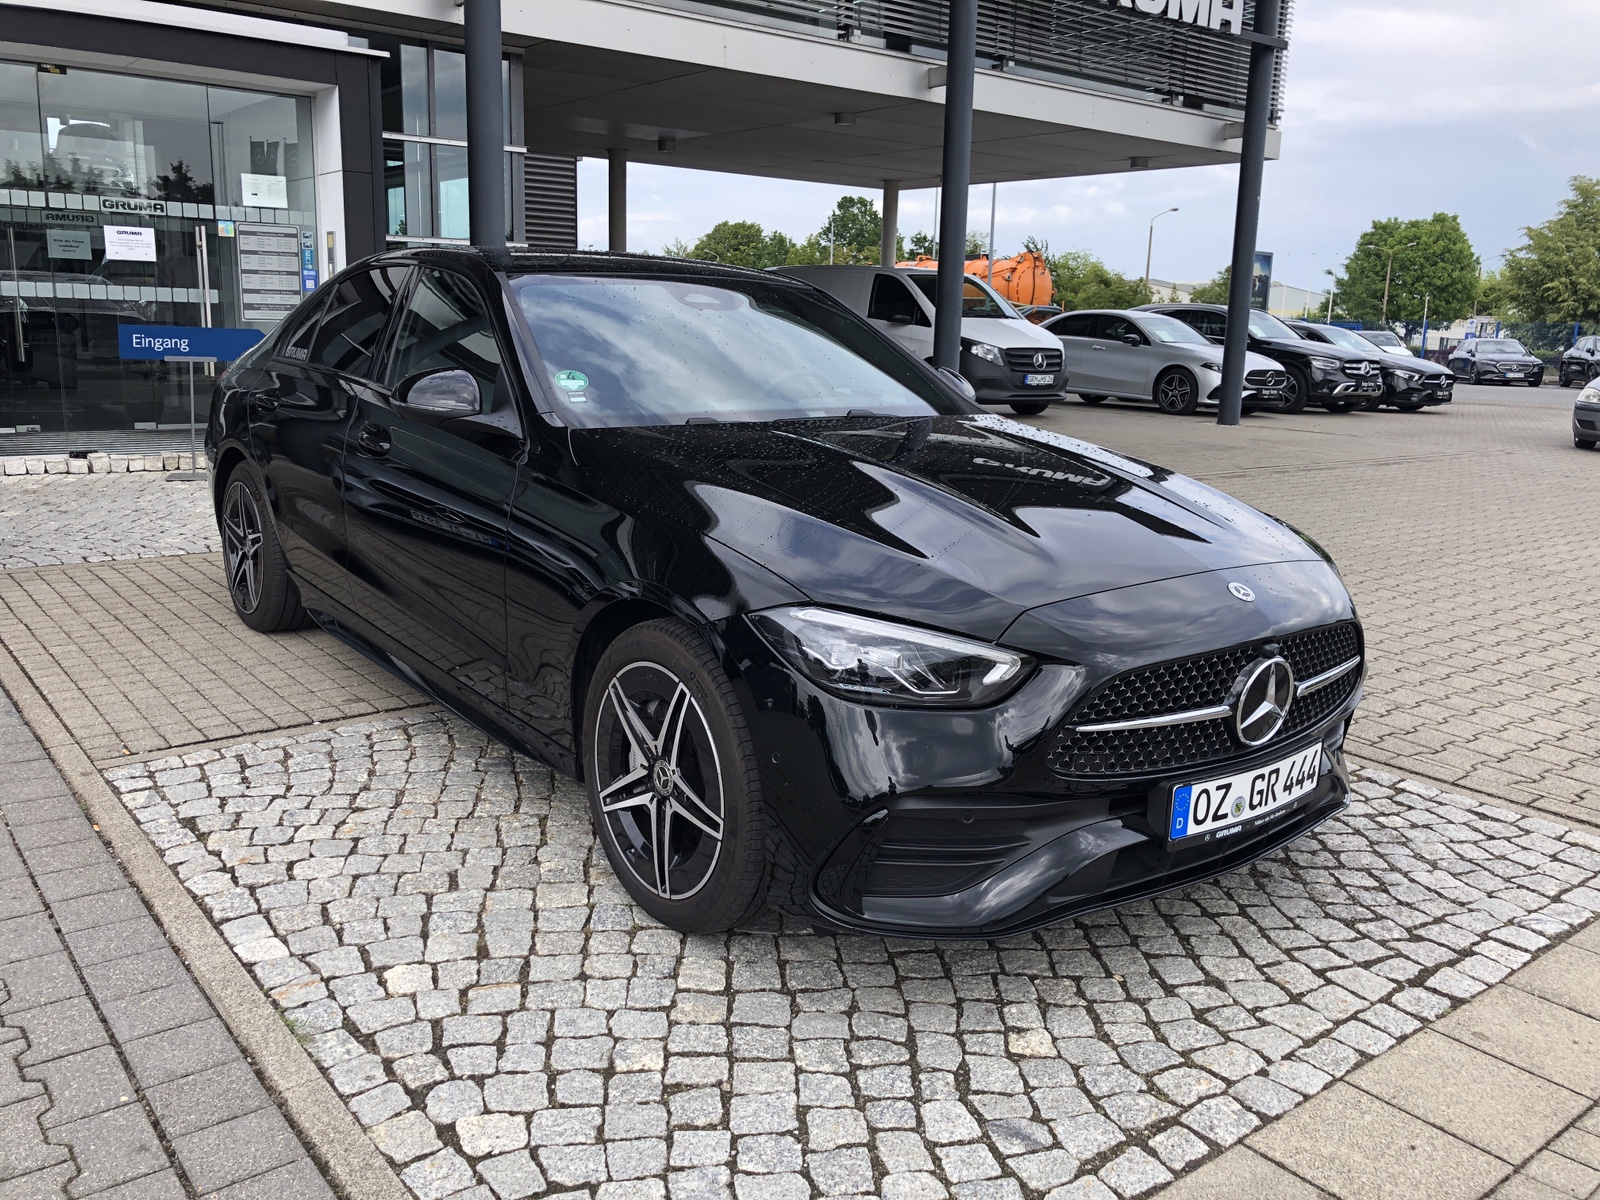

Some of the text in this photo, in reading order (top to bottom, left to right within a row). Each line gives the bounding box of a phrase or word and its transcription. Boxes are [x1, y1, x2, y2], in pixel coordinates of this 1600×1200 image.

[102, 198, 165, 213] GRUMA
[132, 334, 190, 352] Eingang
[566, 371, 576, 380] 4
[1192, 749, 1319, 826] OZ GR 444
[1175, 817, 1184, 829] D
[1215, 825, 1242, 838] GRUMA
